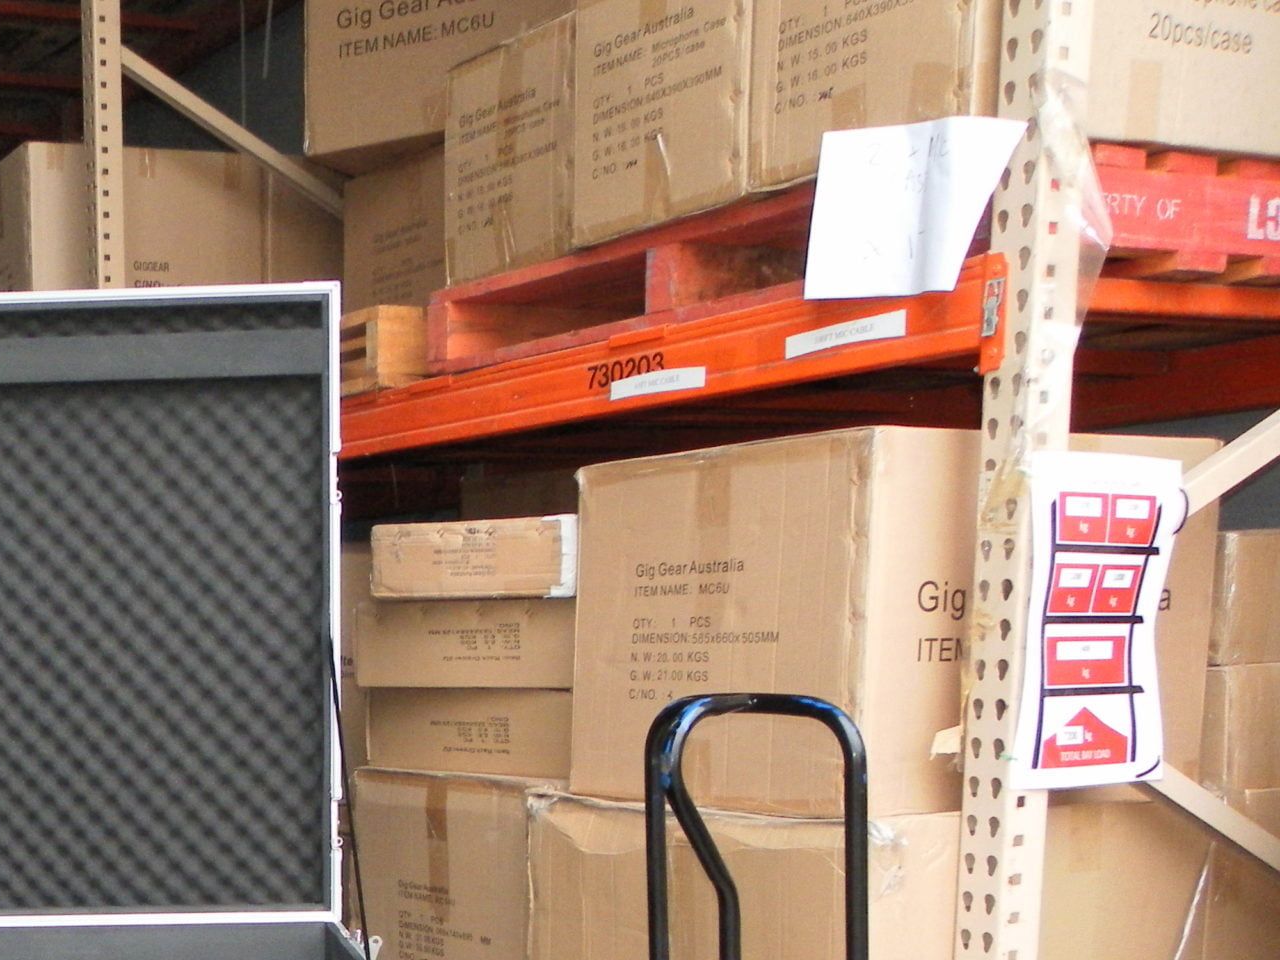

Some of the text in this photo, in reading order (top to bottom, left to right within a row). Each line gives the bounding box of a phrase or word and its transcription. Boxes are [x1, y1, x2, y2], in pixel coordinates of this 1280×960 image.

[337, 7, 371, 30] Gig
[338, 37, 379, 59] ITEM
[441, 11, 495, 37] MC6U
[593, 7, 695, 58] Gig Gear Australia
[842, 29, 869, 48] KGS
[1148, 12, 1253, 55] 20pcs/case
[842, 51, 869, 71] KGS
[1156, 197, 1183, 221] OF
[587, 351, 665, 390] 730203
[635, 558, 745, 580] Gig Gear Australia
[634, 585, 658, 598] ITEM
[917, 580, 967, 621] Gig
[690, 616, 711, 629] PCS
[687, 651, 710, 663] KGS
[686, 670, 709, 682] KGS
[1094, 748, 1112, 760] LOAD
